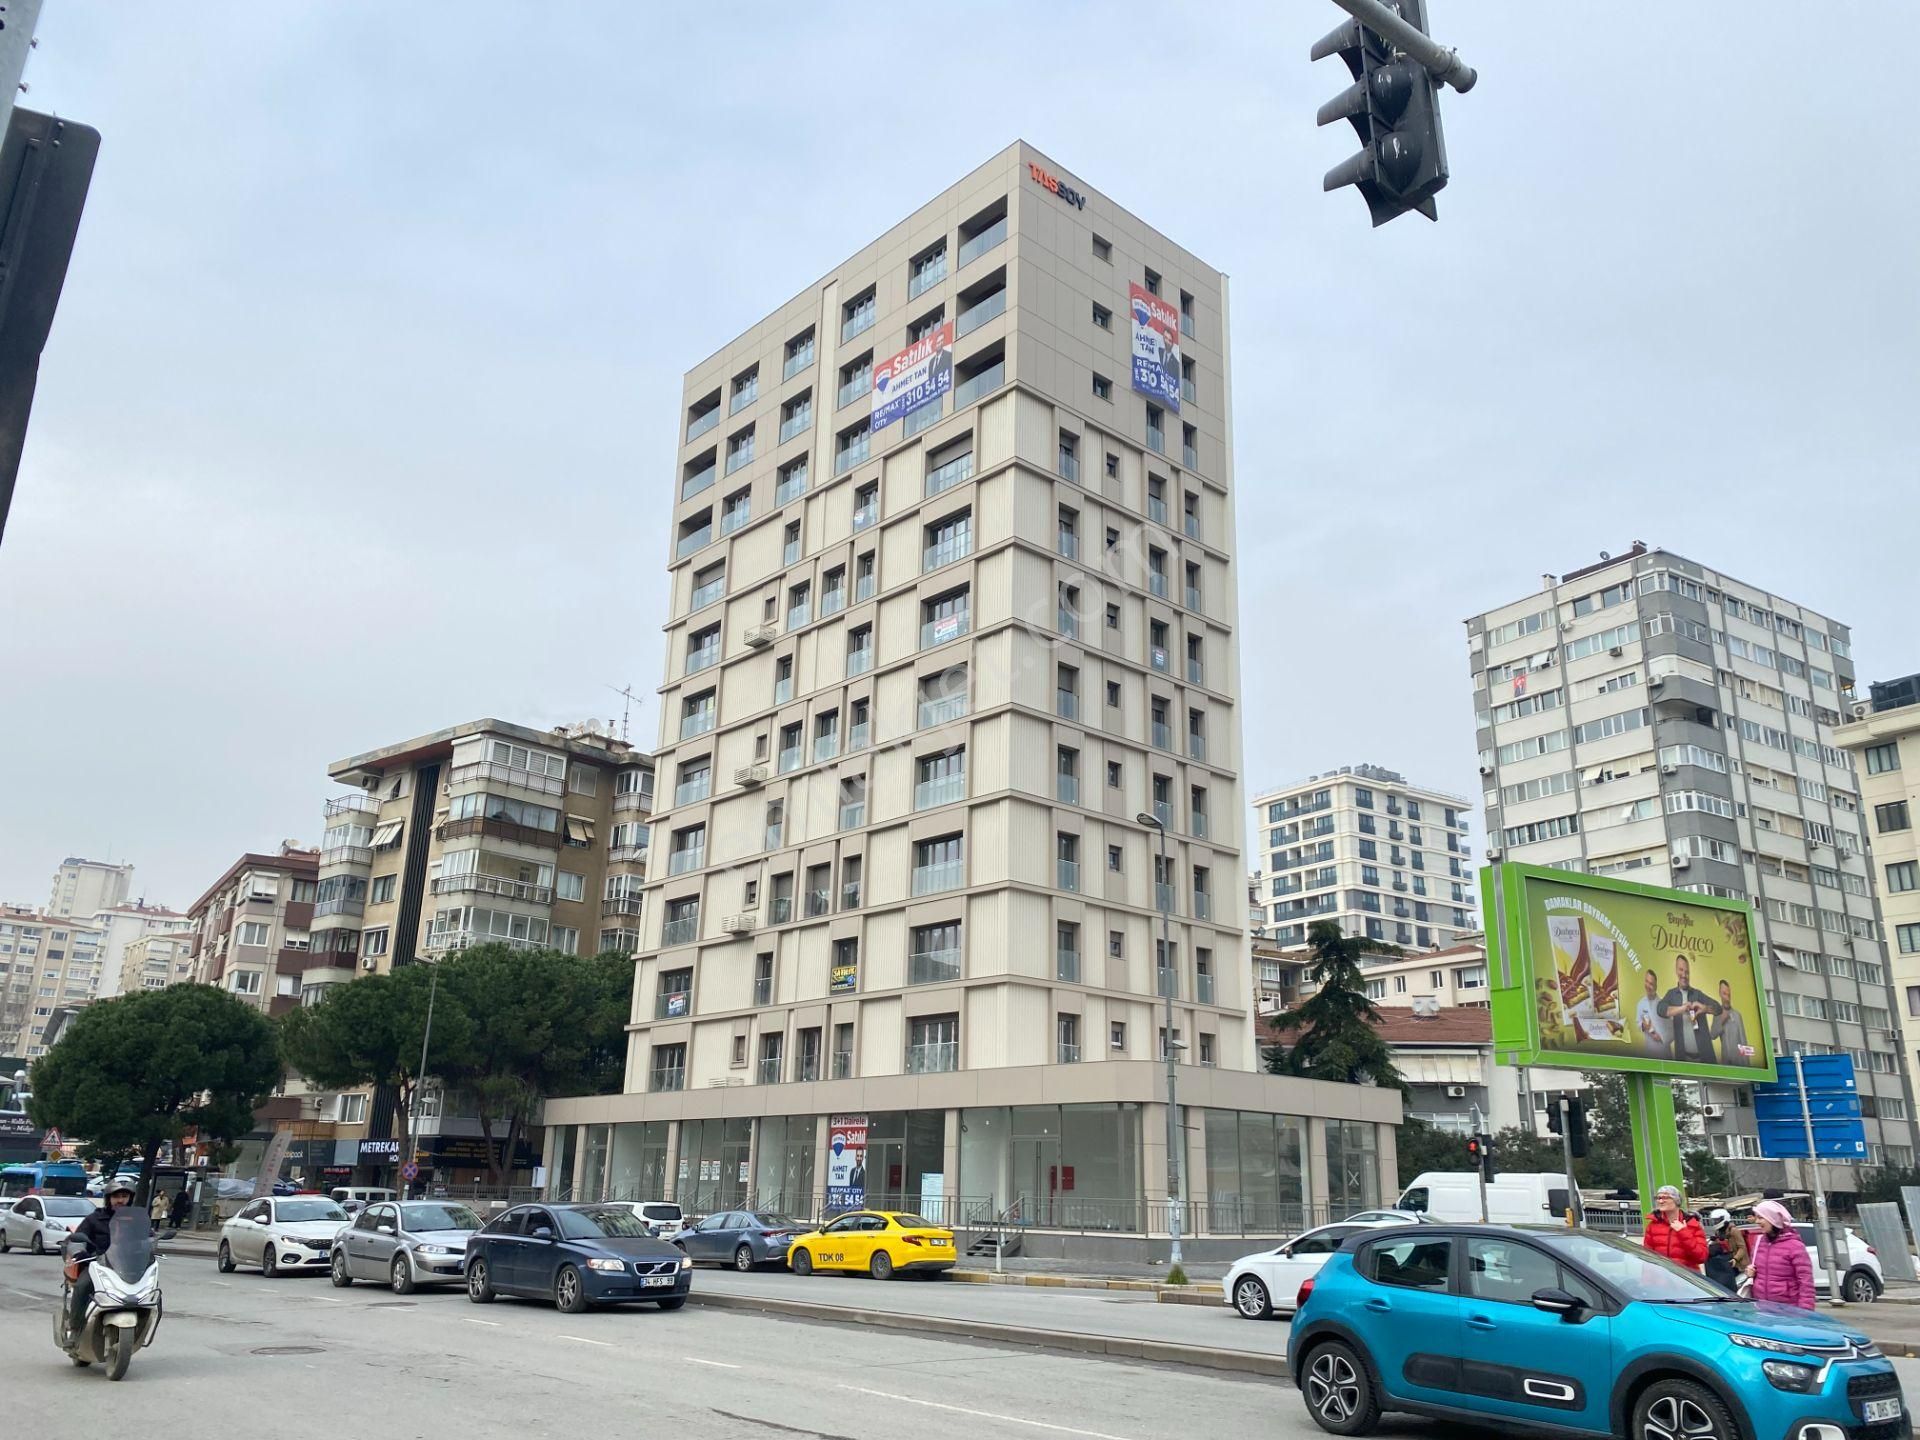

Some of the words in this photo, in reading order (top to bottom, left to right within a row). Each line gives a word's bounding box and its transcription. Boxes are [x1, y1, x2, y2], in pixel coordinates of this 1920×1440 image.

[892, 336, 933, 375] Satılık
[892, 374, 914, 393] AHMET
[914, 367, 927, 380] TAN
[906, 385, 924, 406] 310
[925, 379, 936, 396] 54
[938, 369, 950, 387] 54
[874, 400, 900, 419] RE/MAX
[874, 417, 888, 430] CITY
[1544, 896, 1582, 911] DAMAKLAR
[1583, 902, 1612, 930] BAYRAM
[1611, 925, 1630, 951] ETSİN
[1627, 949, 1642, 973] DİYE
[1650, 923, 1714, 954] Dubaco
[832, 1117, 843, 1126] 3+1
[360, 1142, 400, 1153] METREKAR
[844, 1194, 854, 1206] 54
[818, 1253, 834, 1262] TDK
[835, 1253, 845, 1262] 08
